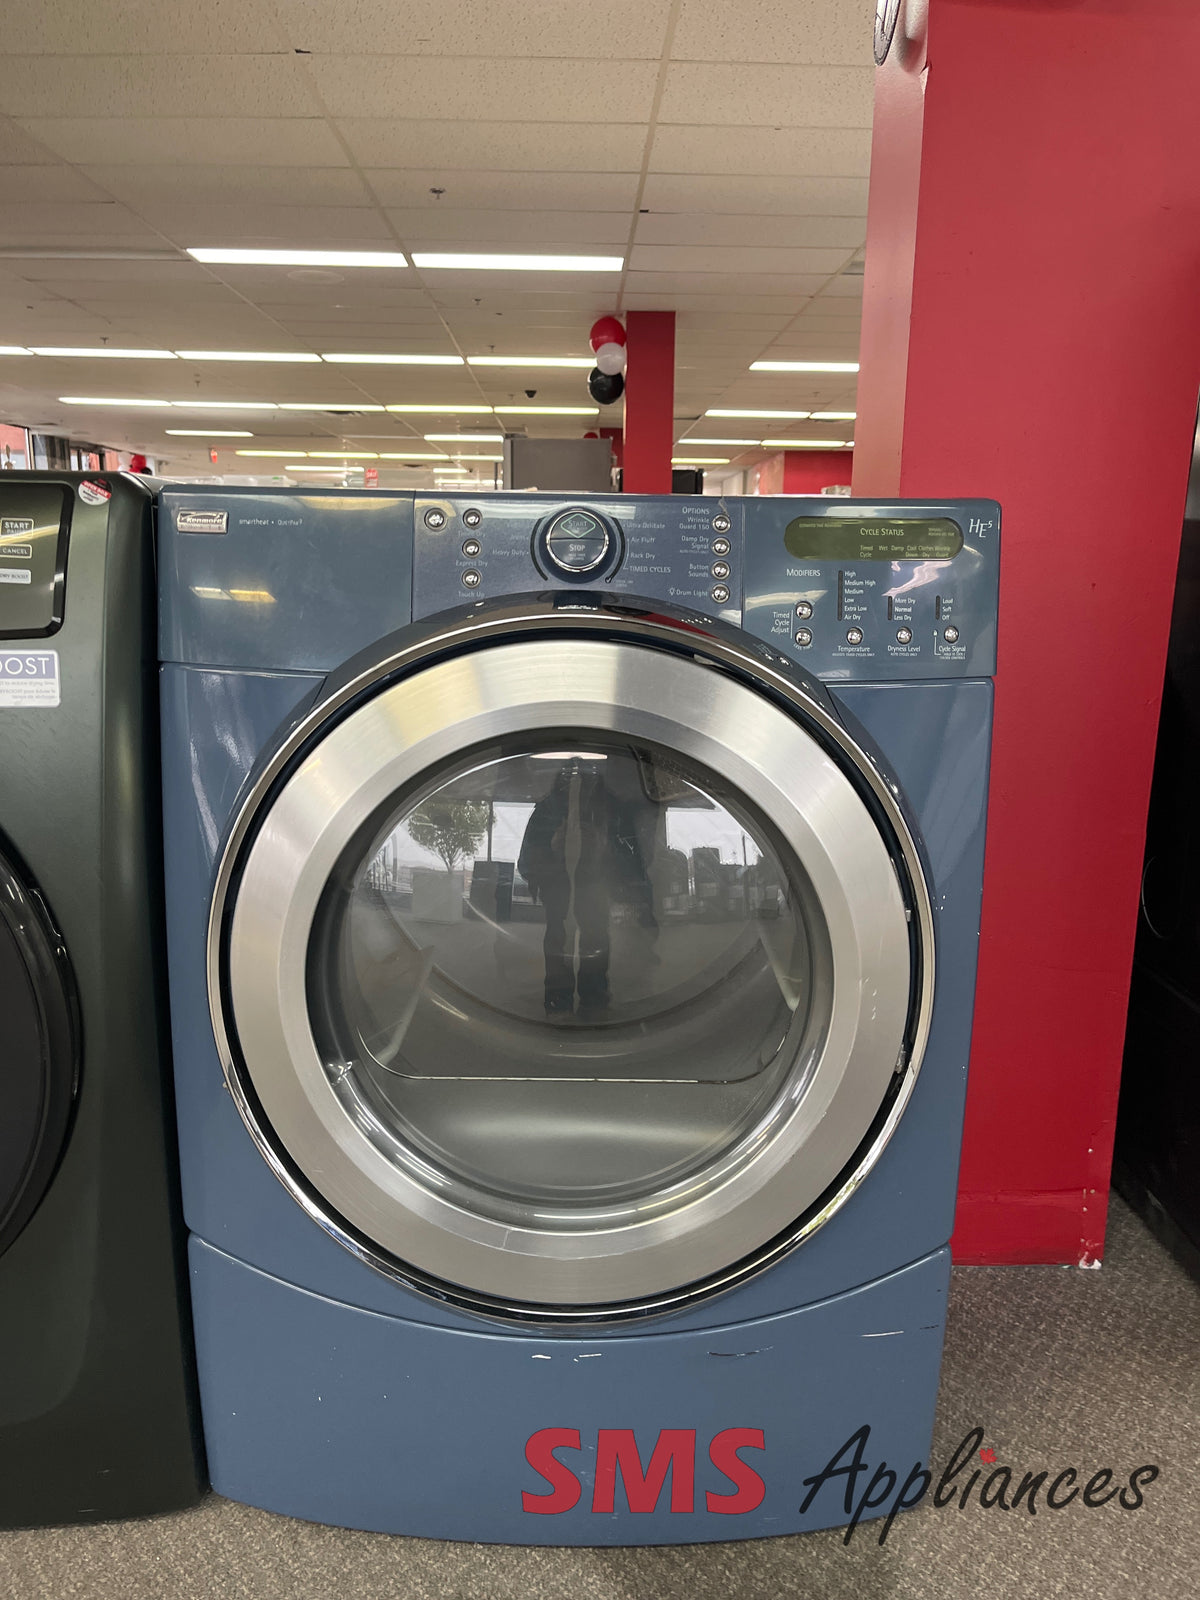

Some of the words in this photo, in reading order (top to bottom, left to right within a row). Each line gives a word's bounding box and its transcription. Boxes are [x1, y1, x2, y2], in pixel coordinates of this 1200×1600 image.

[682, 506, 710, 515] OPTIONS
[4, 521, 30, 529] START
[860, 527, 880, 536] CYCLE
[880, 527, 905, 536] STATUS
[2, 547, 28, 555] CANCEL
[569, 543, 586, 552] STOP
[477, 560, 488, 568] Dry
[786, 568, 821, 577] MODIFIERS
[864, 579, 876, 587] High
[774, 619, 790, 627] Cycle
[771, 626, 790, 635] Adjust
[887, 645, 907, 653] Dryness
[0, 656, 50, 675] OST
